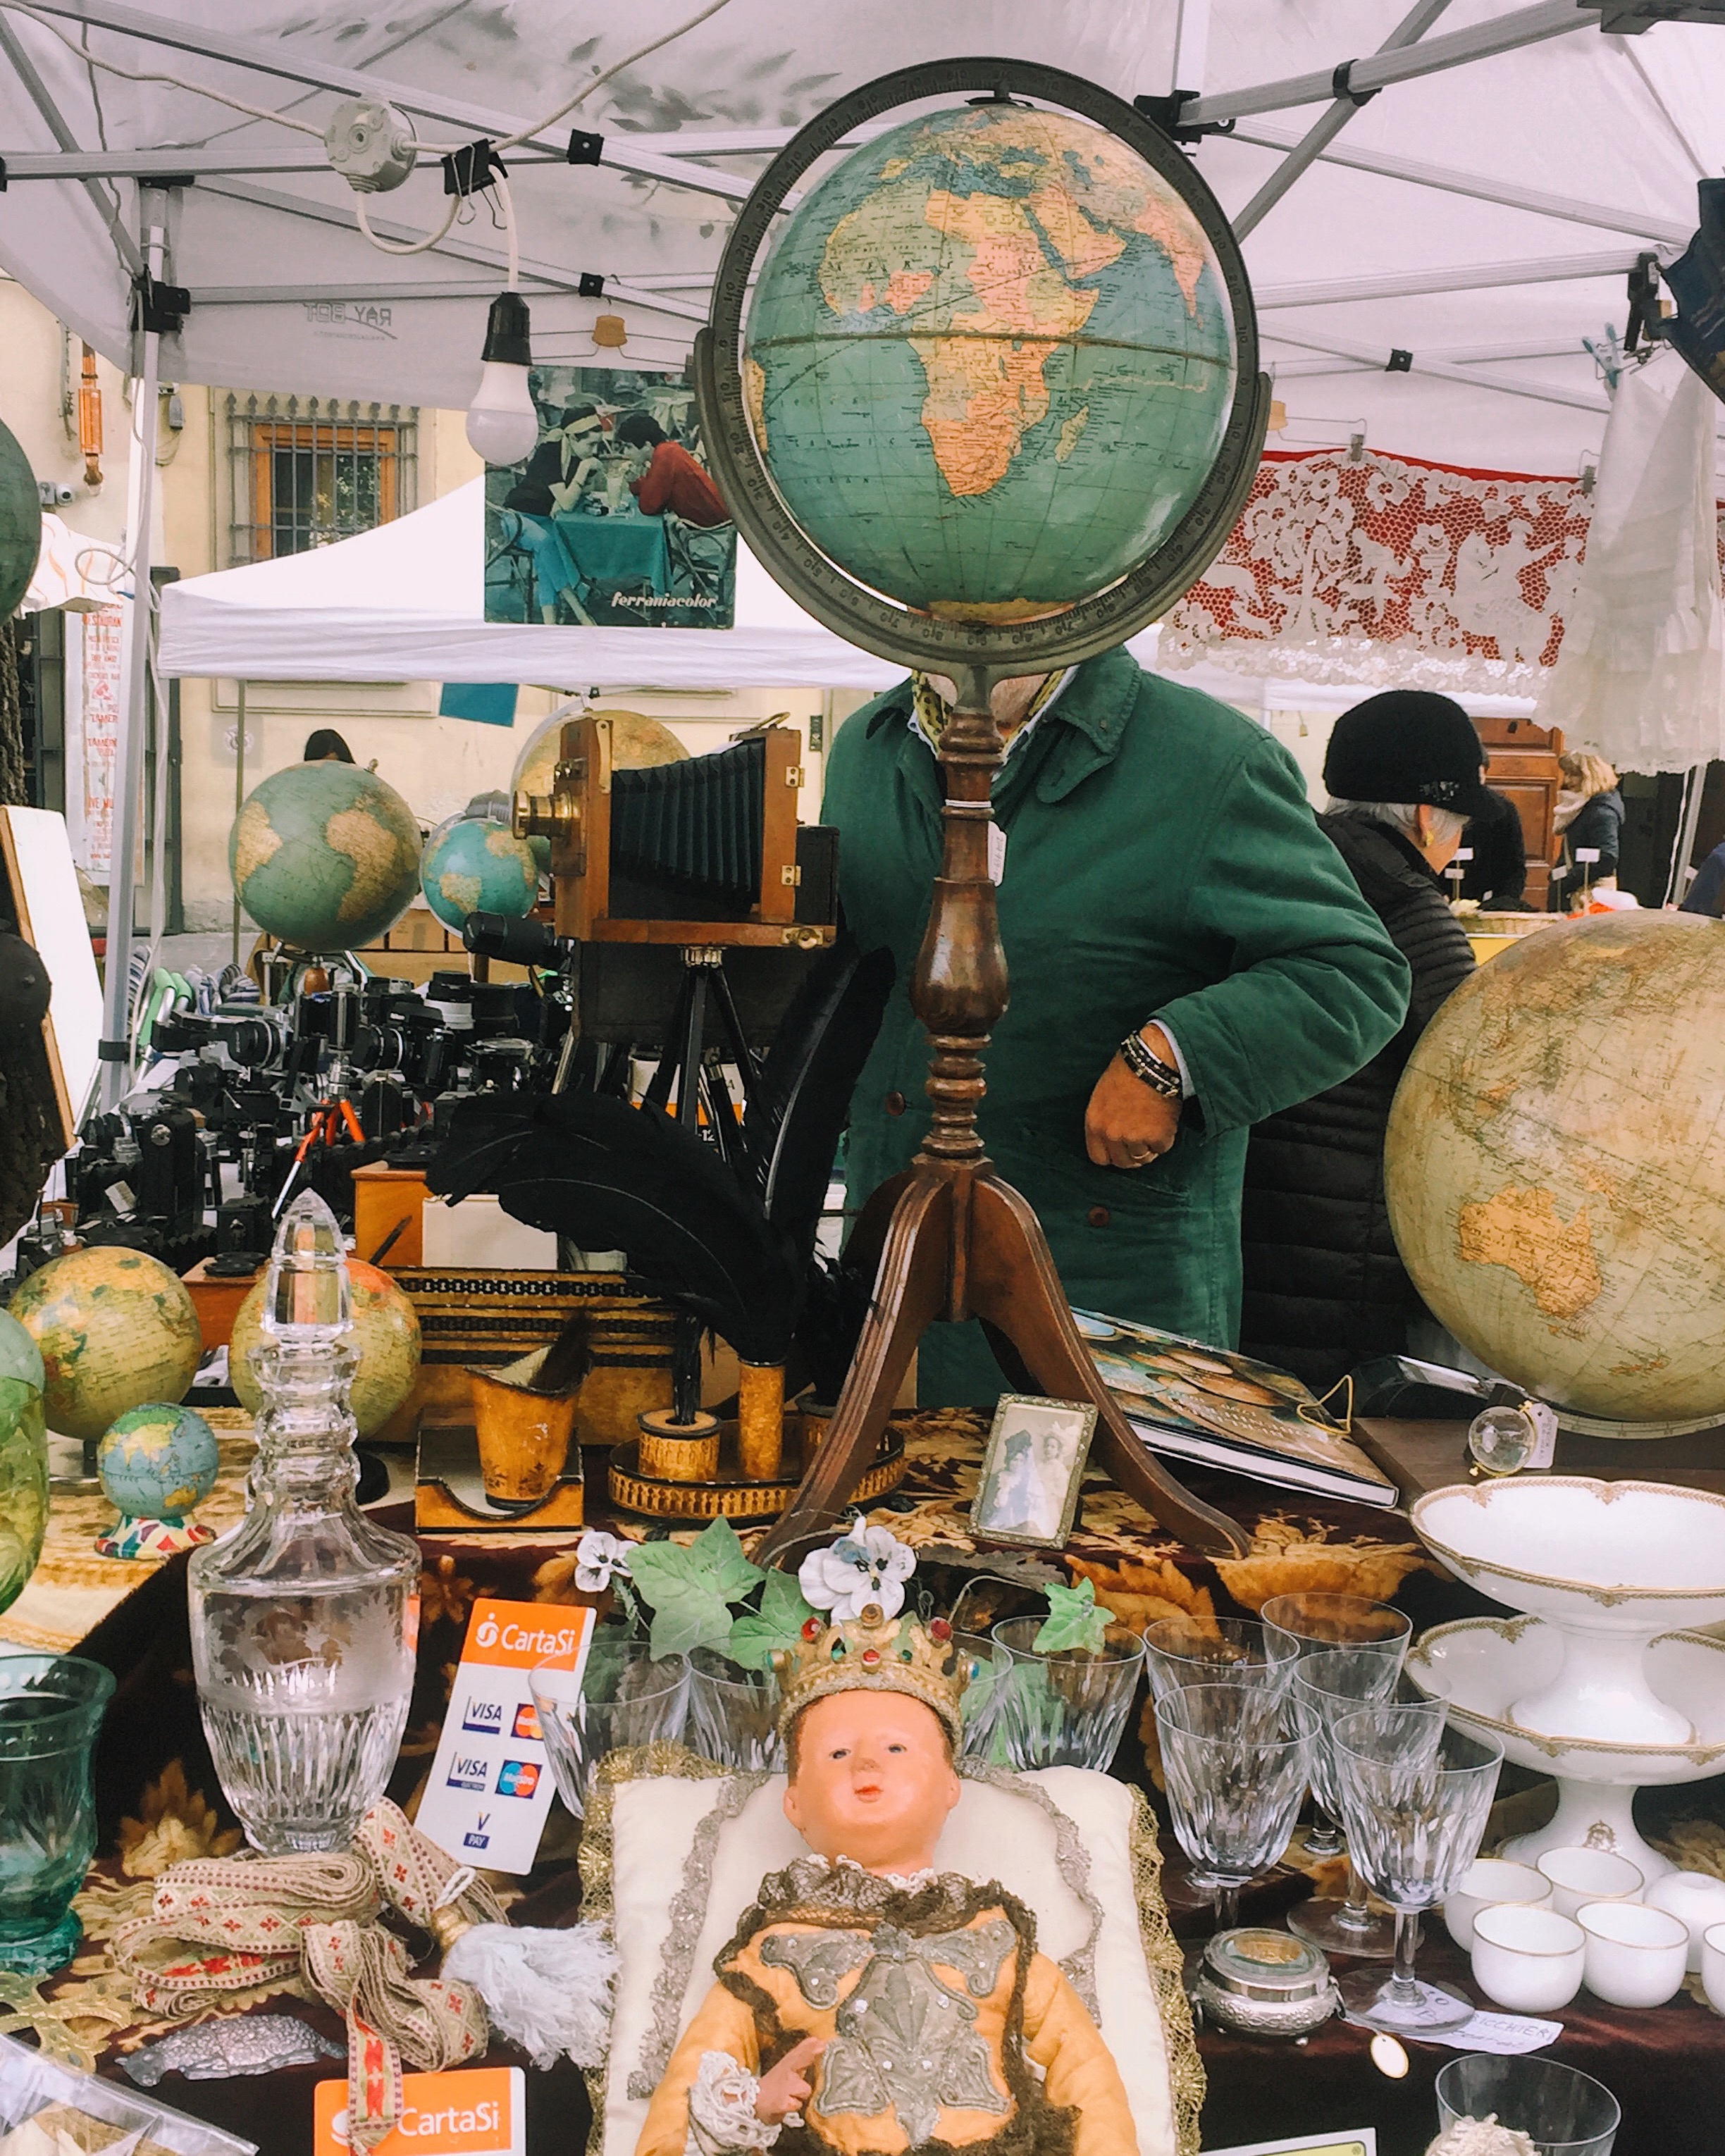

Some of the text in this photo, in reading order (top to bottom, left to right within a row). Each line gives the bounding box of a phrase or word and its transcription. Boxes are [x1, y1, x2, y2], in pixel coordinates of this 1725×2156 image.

[611, 591, 717, 608] ferraniacolor
[501, 1623, 576, 1656] CartaSi
[471, 1701, 502, 1721] VISA
[457, 1757, 488, 1778] VISA
[477, 1811, 491, 1831] V
[467, 1835, 486, 1847] PAY
[397, 2101, 498, 2136] CartaSi
